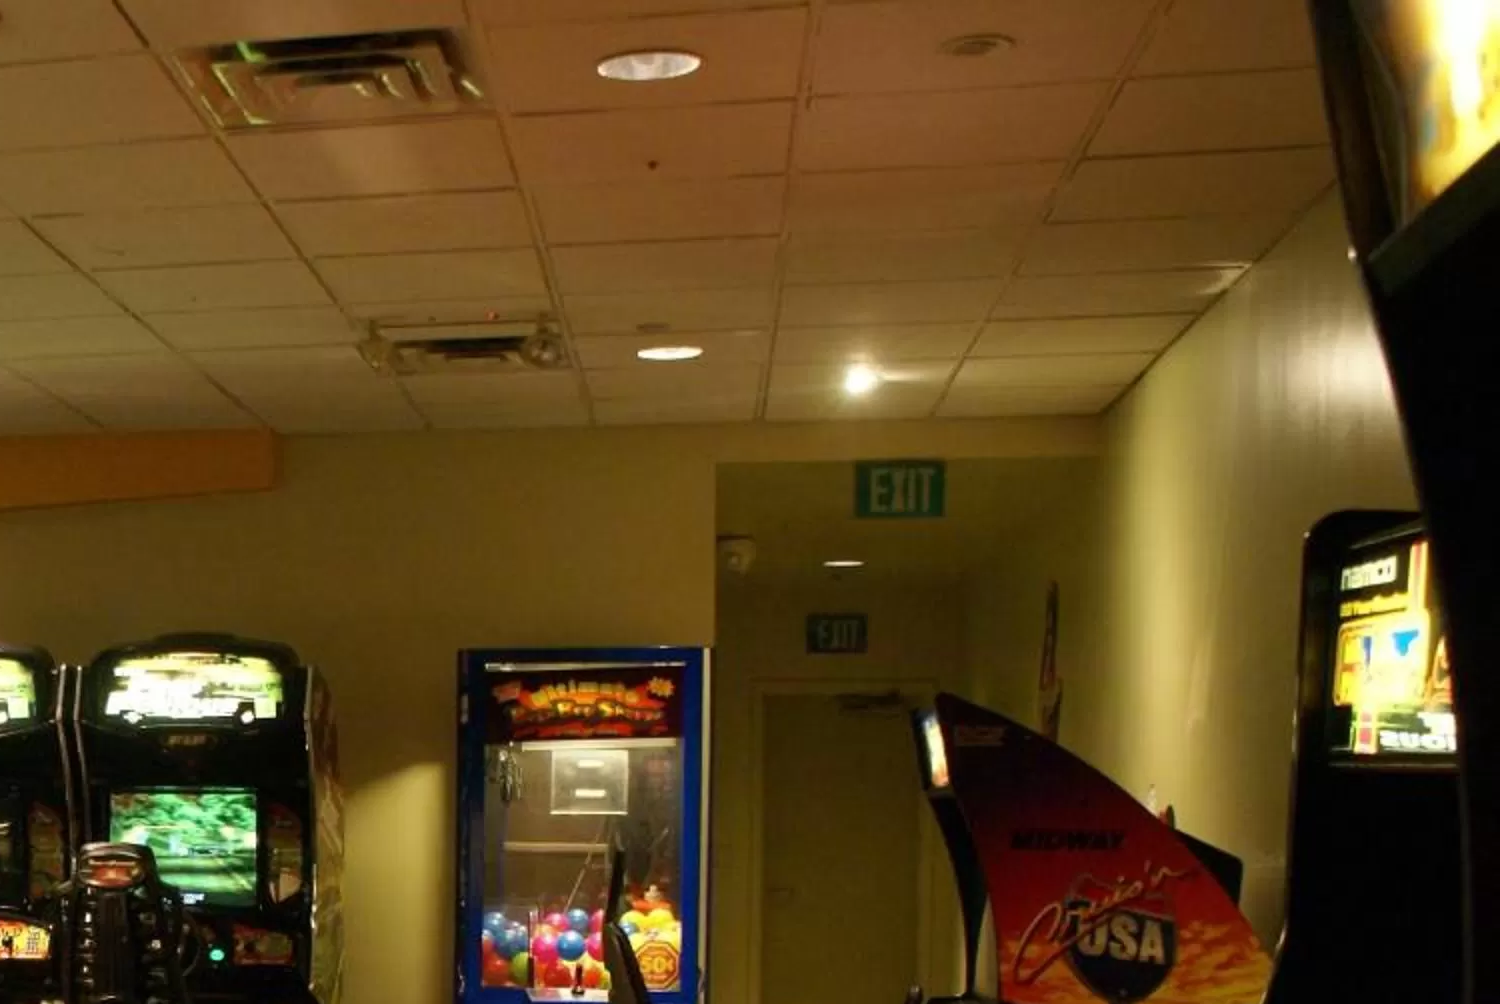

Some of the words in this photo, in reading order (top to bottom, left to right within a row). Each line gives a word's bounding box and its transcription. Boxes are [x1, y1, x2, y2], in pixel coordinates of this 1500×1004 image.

[869, 467, 937, 513] EXIT
[817, 618, 860, 650] EXIT
[1008, 829, 1125, 851] MIDWAY
[1075, 910, 1166, 966] USA
